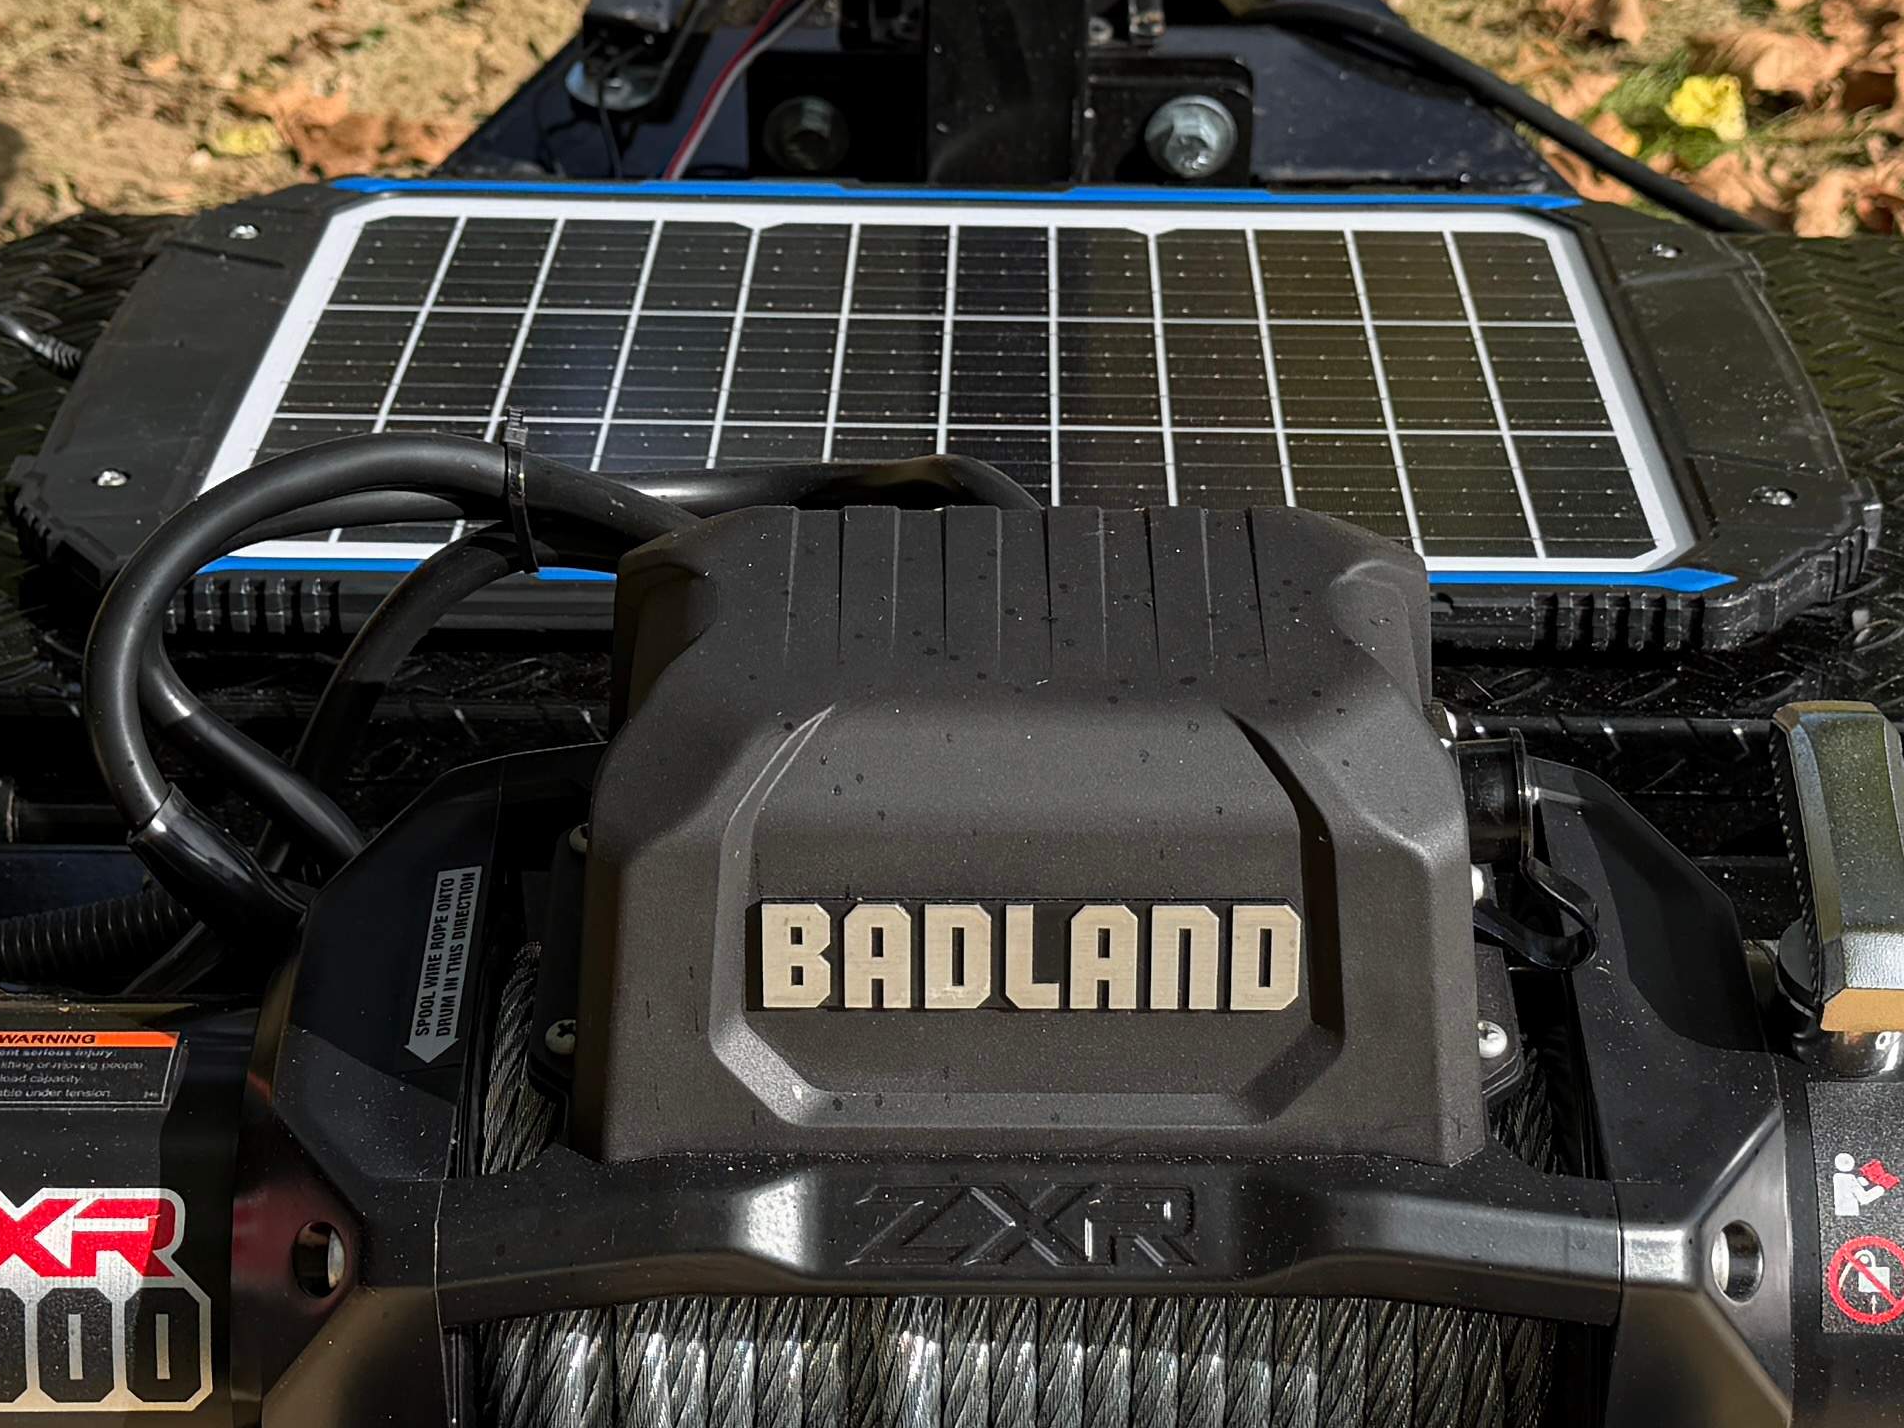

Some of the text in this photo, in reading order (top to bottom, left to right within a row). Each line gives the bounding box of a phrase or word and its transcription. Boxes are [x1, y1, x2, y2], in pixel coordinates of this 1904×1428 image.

[415, 877, 456, 1037] SPOOL WIRE ROPE ONTO
[435, 871, 477, 1037] DRUM IN THIS DIRECTION
[761, 902, 1302, 1011] BADLAND
[0, 1061, 35, 1071] lifting
[36, 1061, 50, 1071] or
[51, 1061, 97, 1071] moving
[22, 1049, 73, 1059] serious
[24, 1088, 63, 1099] under
[845, 1181, 1198, 1269] ZXR
